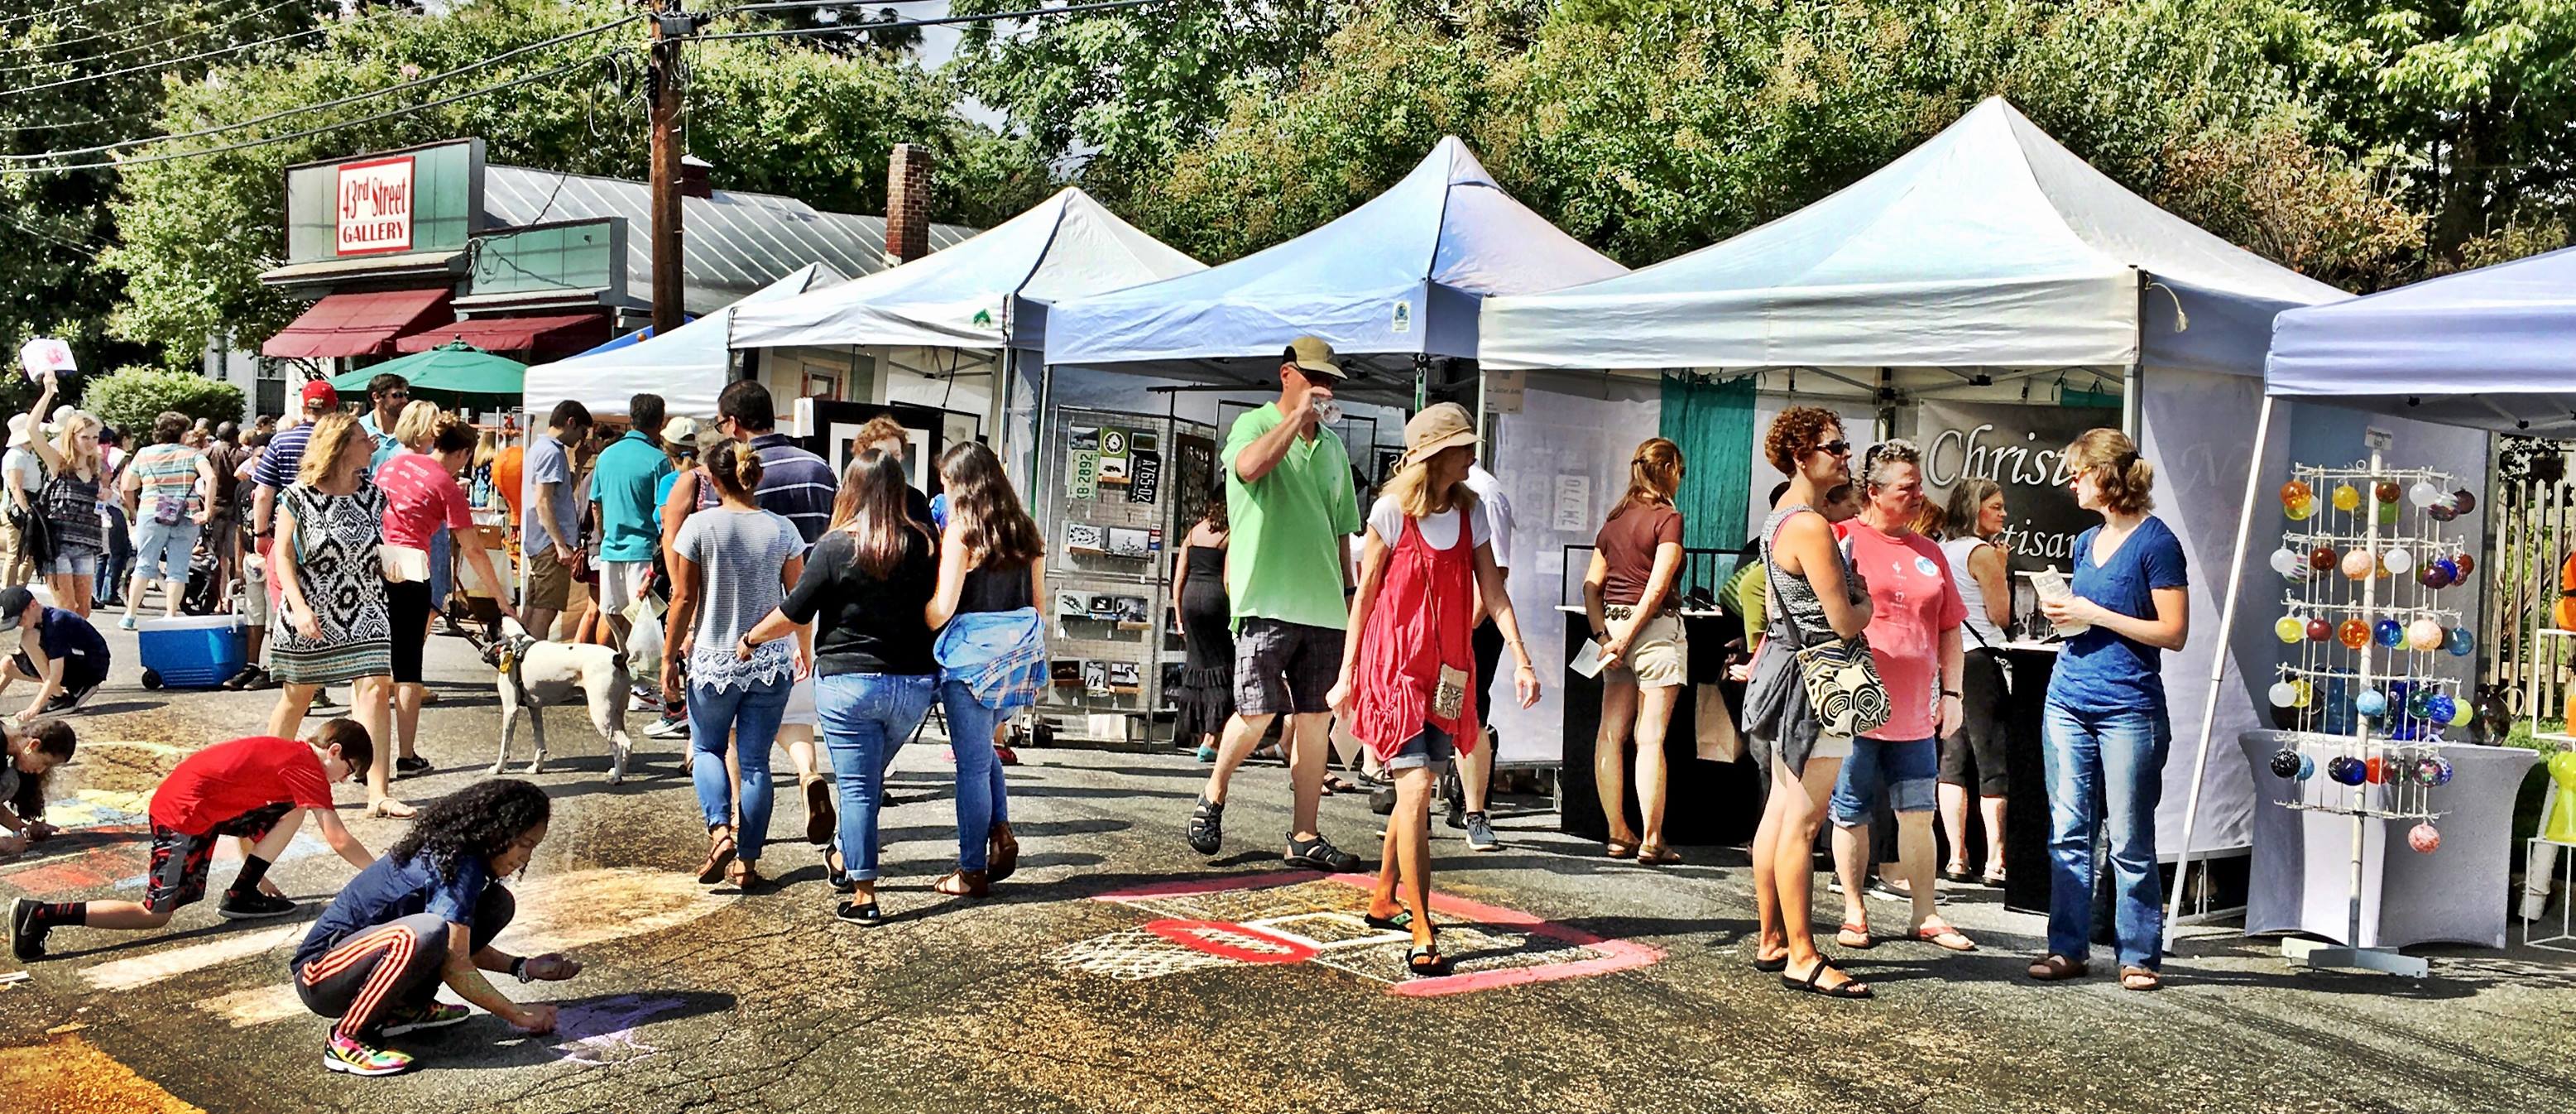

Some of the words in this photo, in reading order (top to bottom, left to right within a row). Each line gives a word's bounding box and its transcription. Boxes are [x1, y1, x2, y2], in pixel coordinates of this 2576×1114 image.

[343, 176, 369, 219] 43rd
[372, 176, 406, 217] Street
[343, 221, 405, 243] GALLERY
